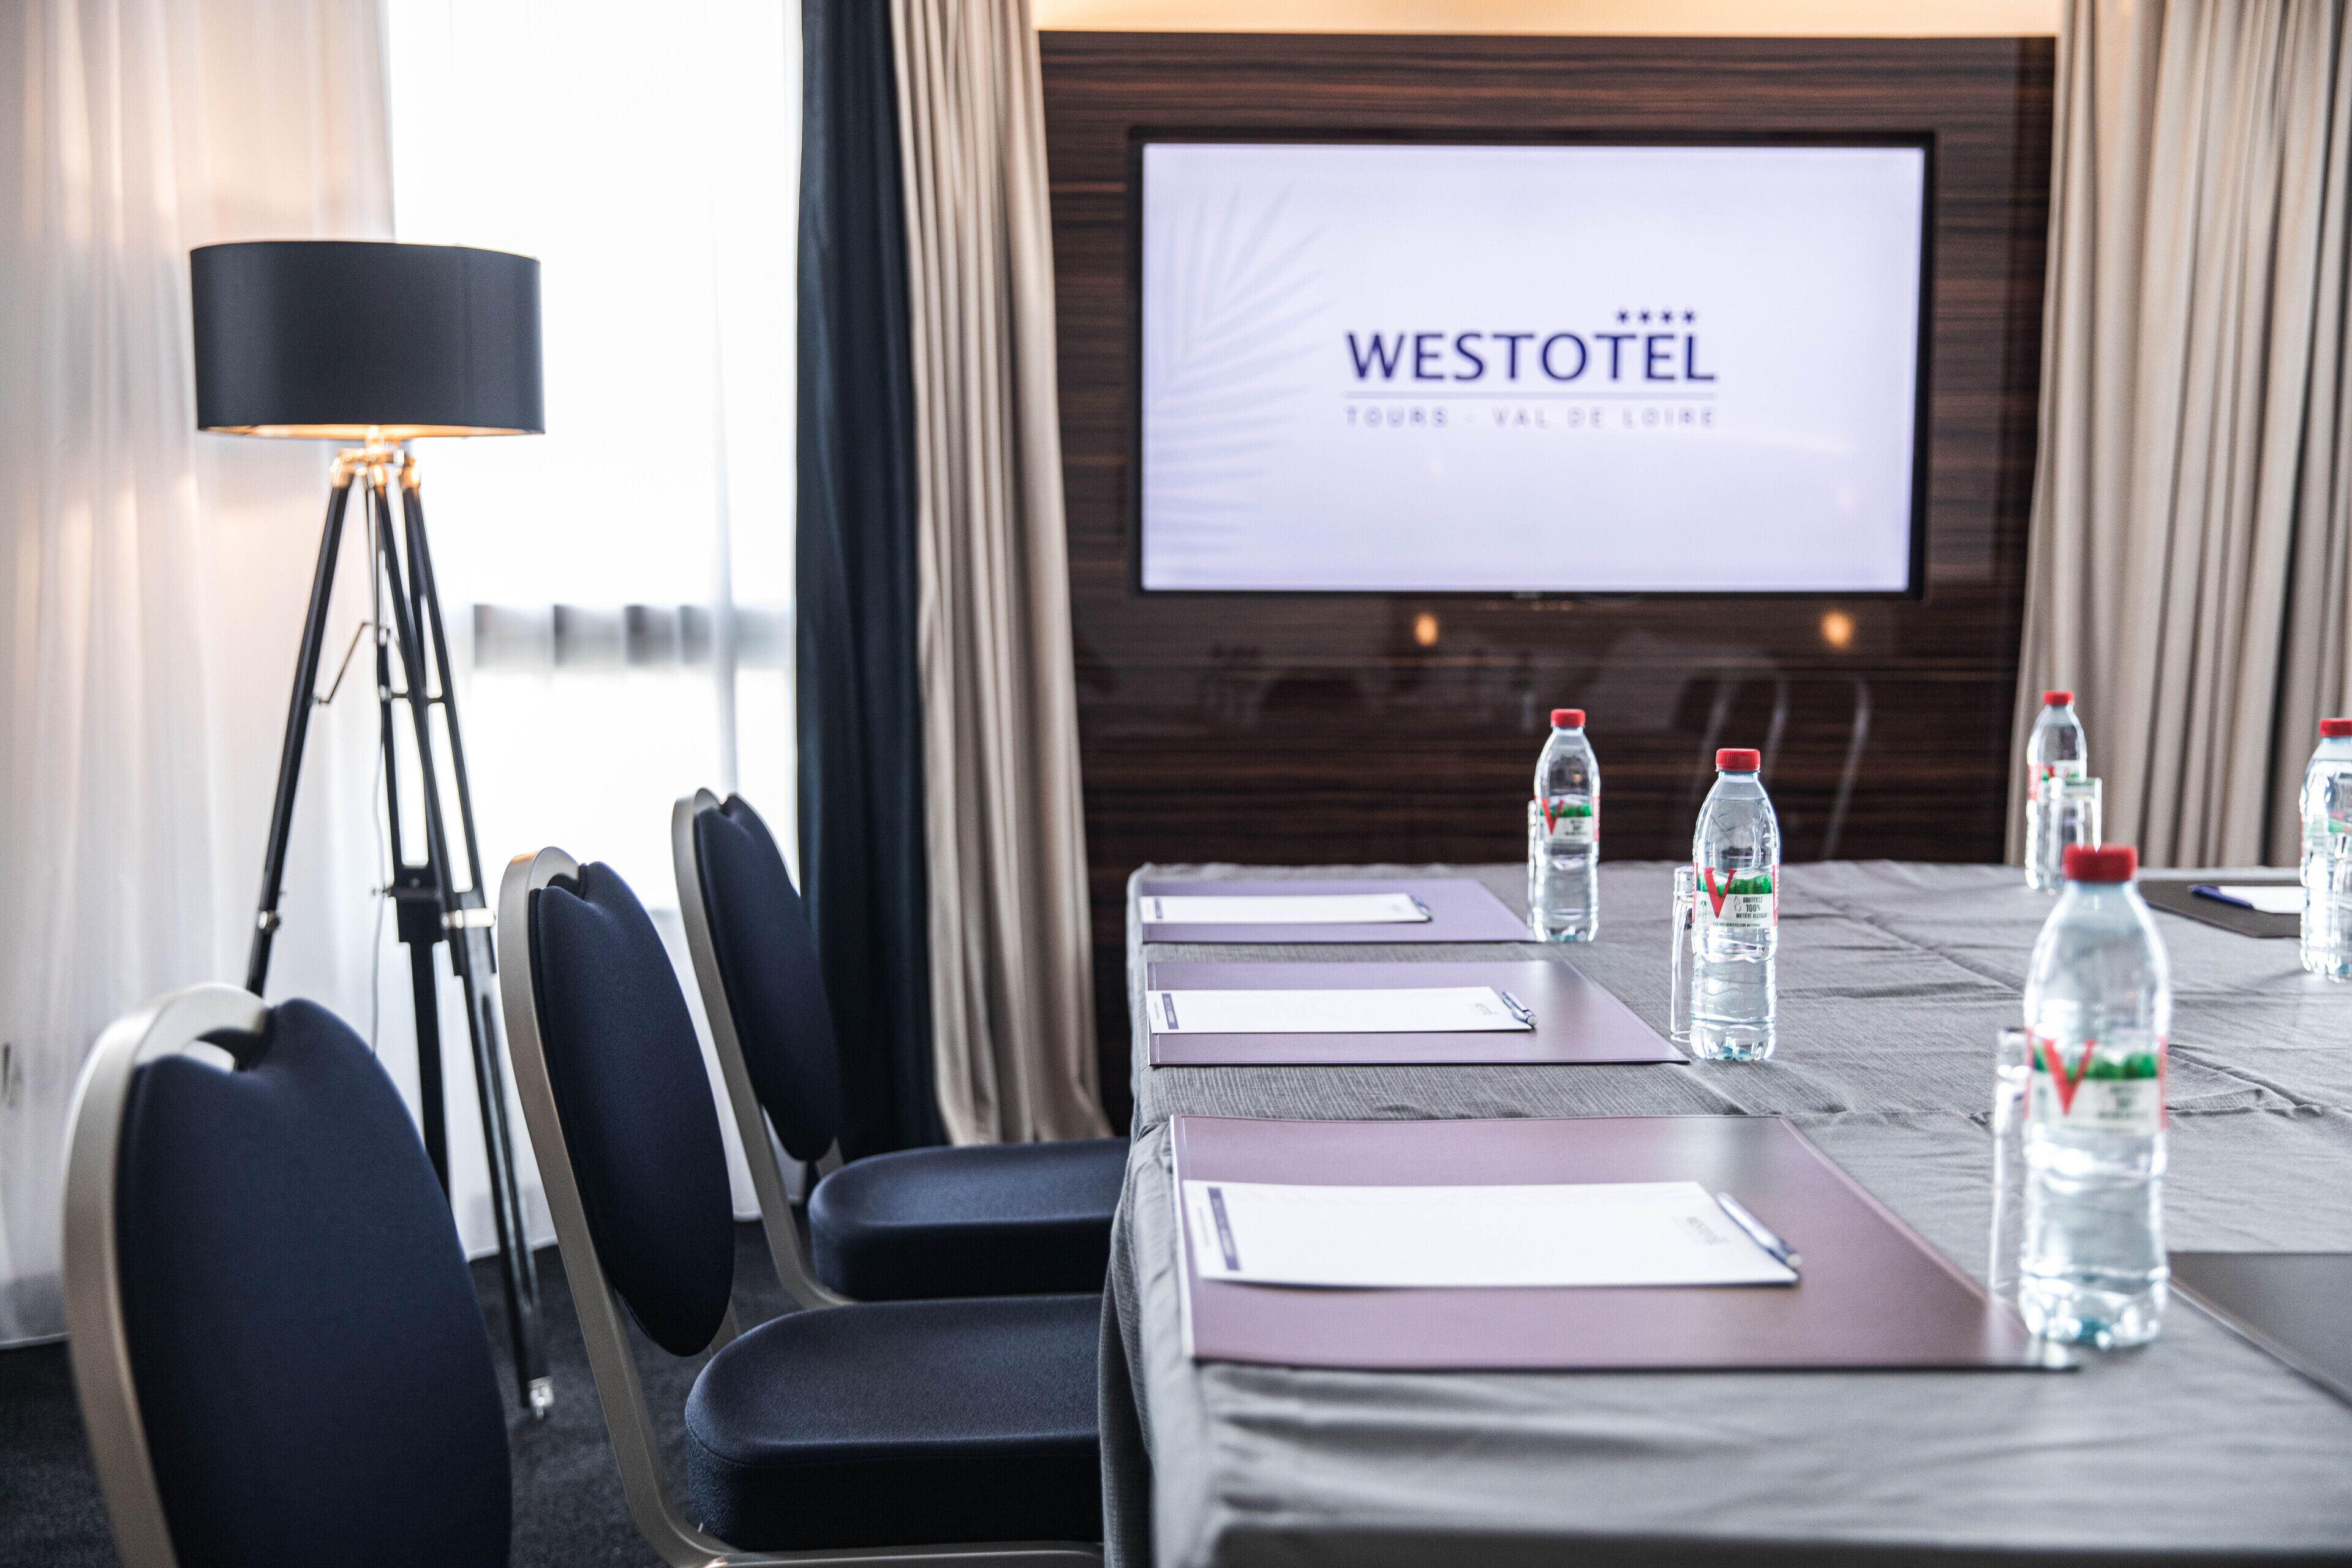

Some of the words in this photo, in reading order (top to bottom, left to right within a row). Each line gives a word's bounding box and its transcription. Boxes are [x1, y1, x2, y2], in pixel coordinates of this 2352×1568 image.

[1347, 332, 1717, 380] WESTOTEL
[1346, 405, 1449, 429] TOURS
[1491, 405, 1548, 429] VAL
[1567, 405, 1603, 429] DE
[1622, 405, 1716, 429] LOIRE
[1540, 797, 1565, 835] V
[1703, 867, 1737, 919] V
[2041, 1038, 2097, 1118] V
